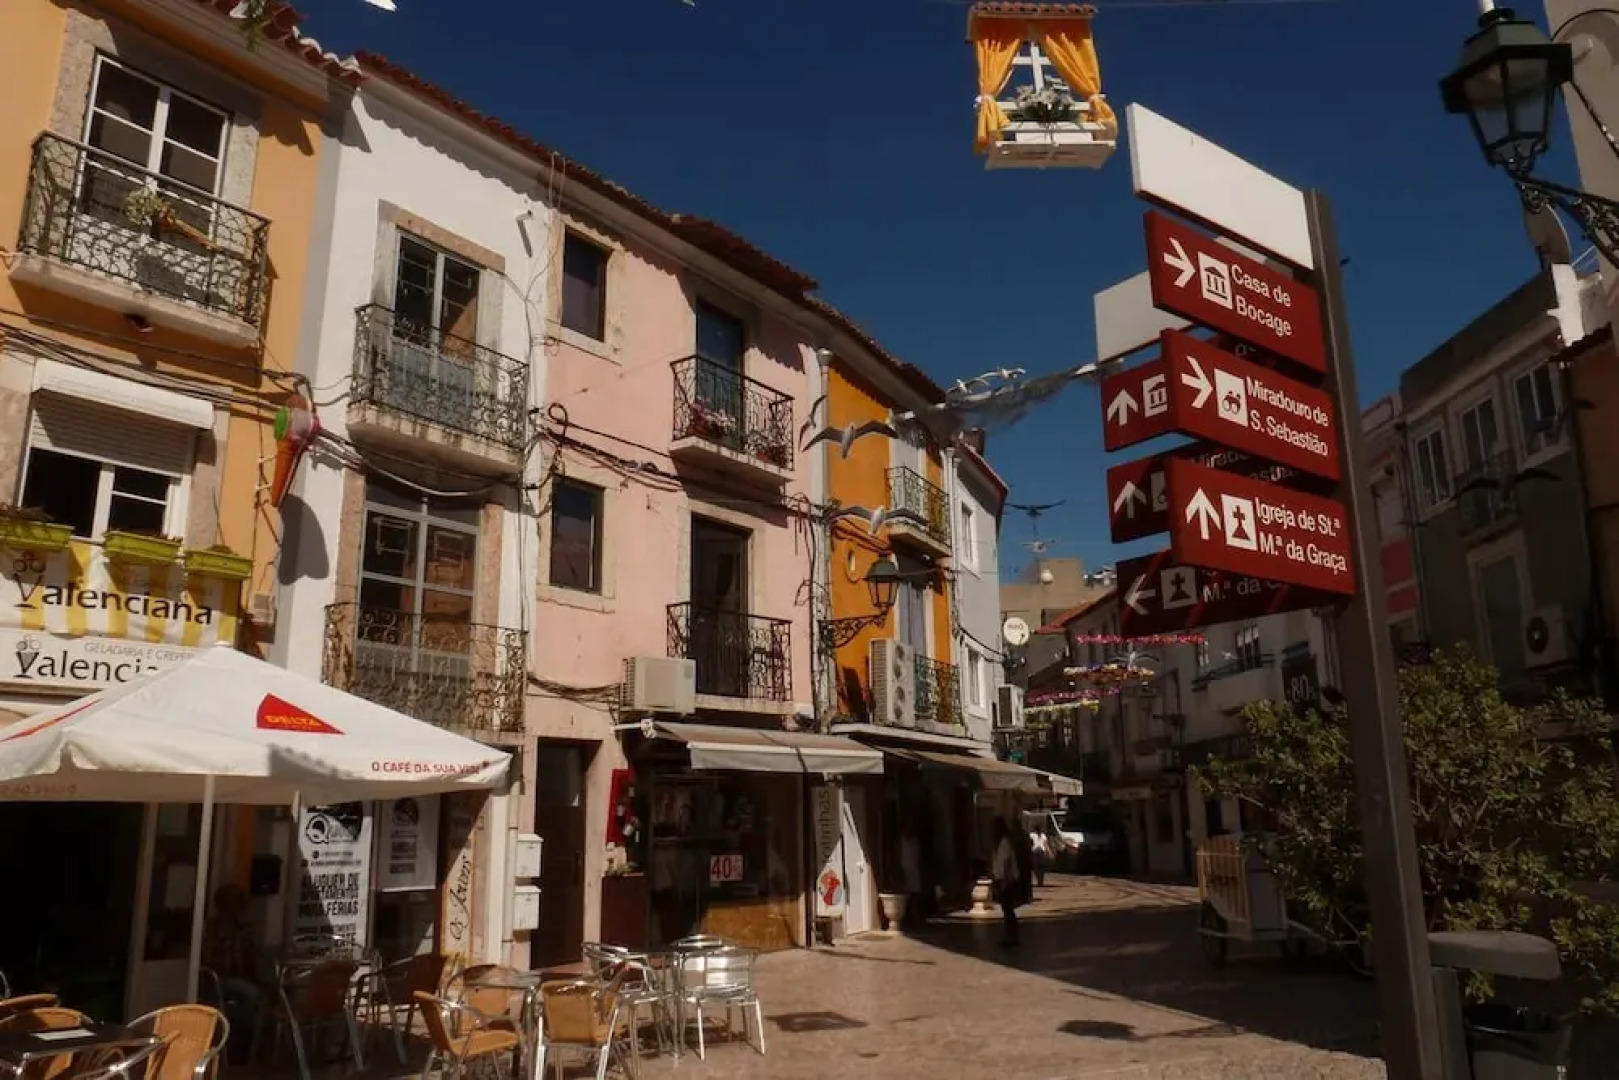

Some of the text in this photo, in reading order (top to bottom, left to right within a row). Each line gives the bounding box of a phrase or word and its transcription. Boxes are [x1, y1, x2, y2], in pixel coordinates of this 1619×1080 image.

[1231, 263, 1291, 307] Casa de
[1235, 294, 1293, 337] Bocage
[1246, 375, 1329, 427] Miradouro de
[1250, 409, 1328, 457] S. Sebastião
[1255, 497, 1296, 529] Igreja
[1298, 510, 1316, 532] de
[1286, 539, 1305, 562] da
[1307, 543, 1348, 575] Graça
[14, 572, 212, 625] Valenciana
[14, 650, 159, 683] Valenci
[371, 760, 380, 772] O
[383, 760, 411, 773] CAFÉ
[413, 762, 430, 774] DA
[432, 763, 456, 775] SUA
